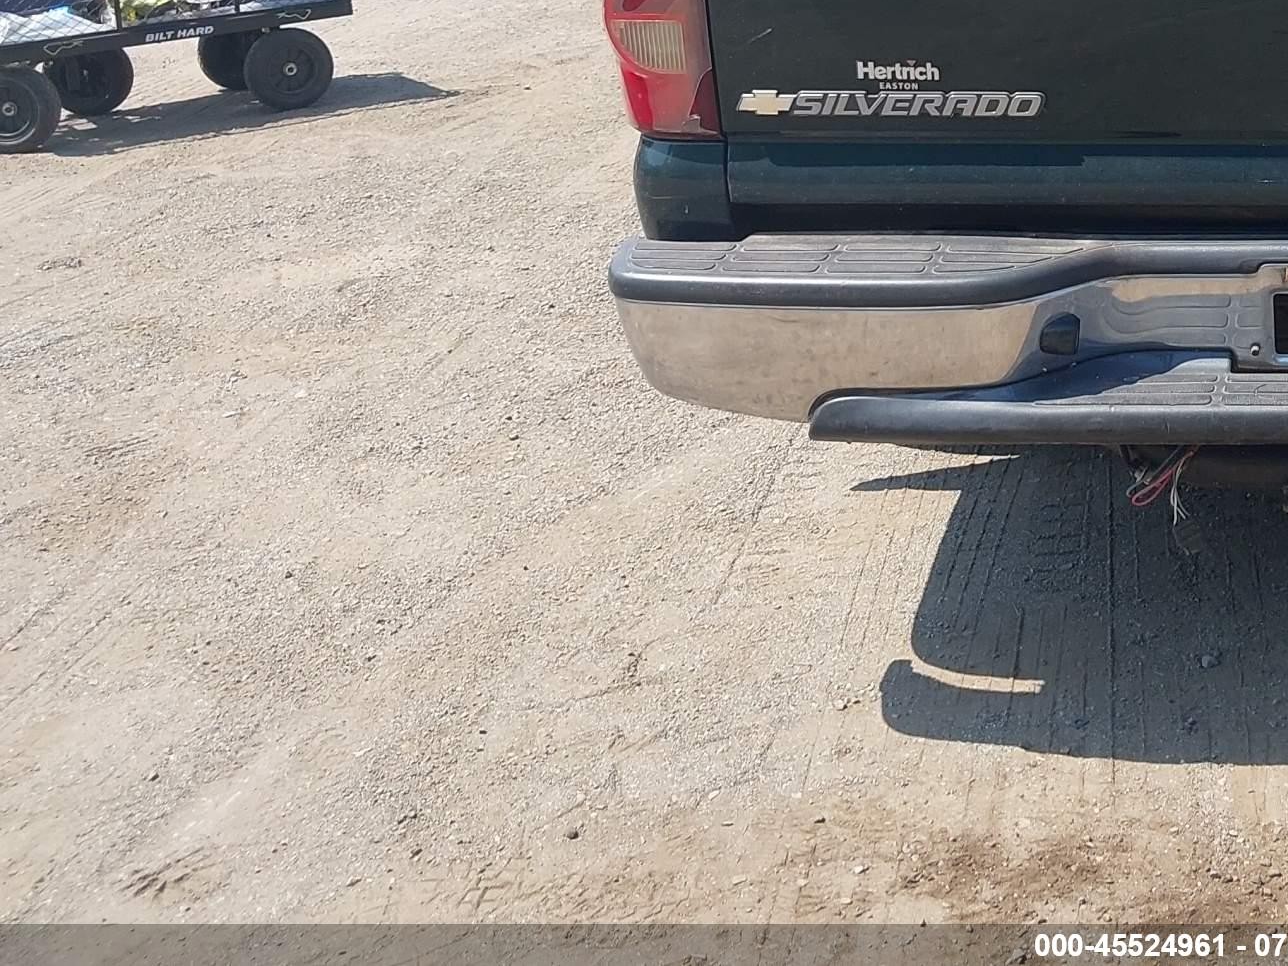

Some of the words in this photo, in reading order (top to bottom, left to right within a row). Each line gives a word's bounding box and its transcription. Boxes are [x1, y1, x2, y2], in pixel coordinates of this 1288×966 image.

[145, 31, 175, 42] BILT
[176, 25, 215, 37] HARD
[856, 60, 940, 81] Hertrich
[879, 82, 919, 90] EASTON
[794, 90, 1046, 117] SILVERADO
